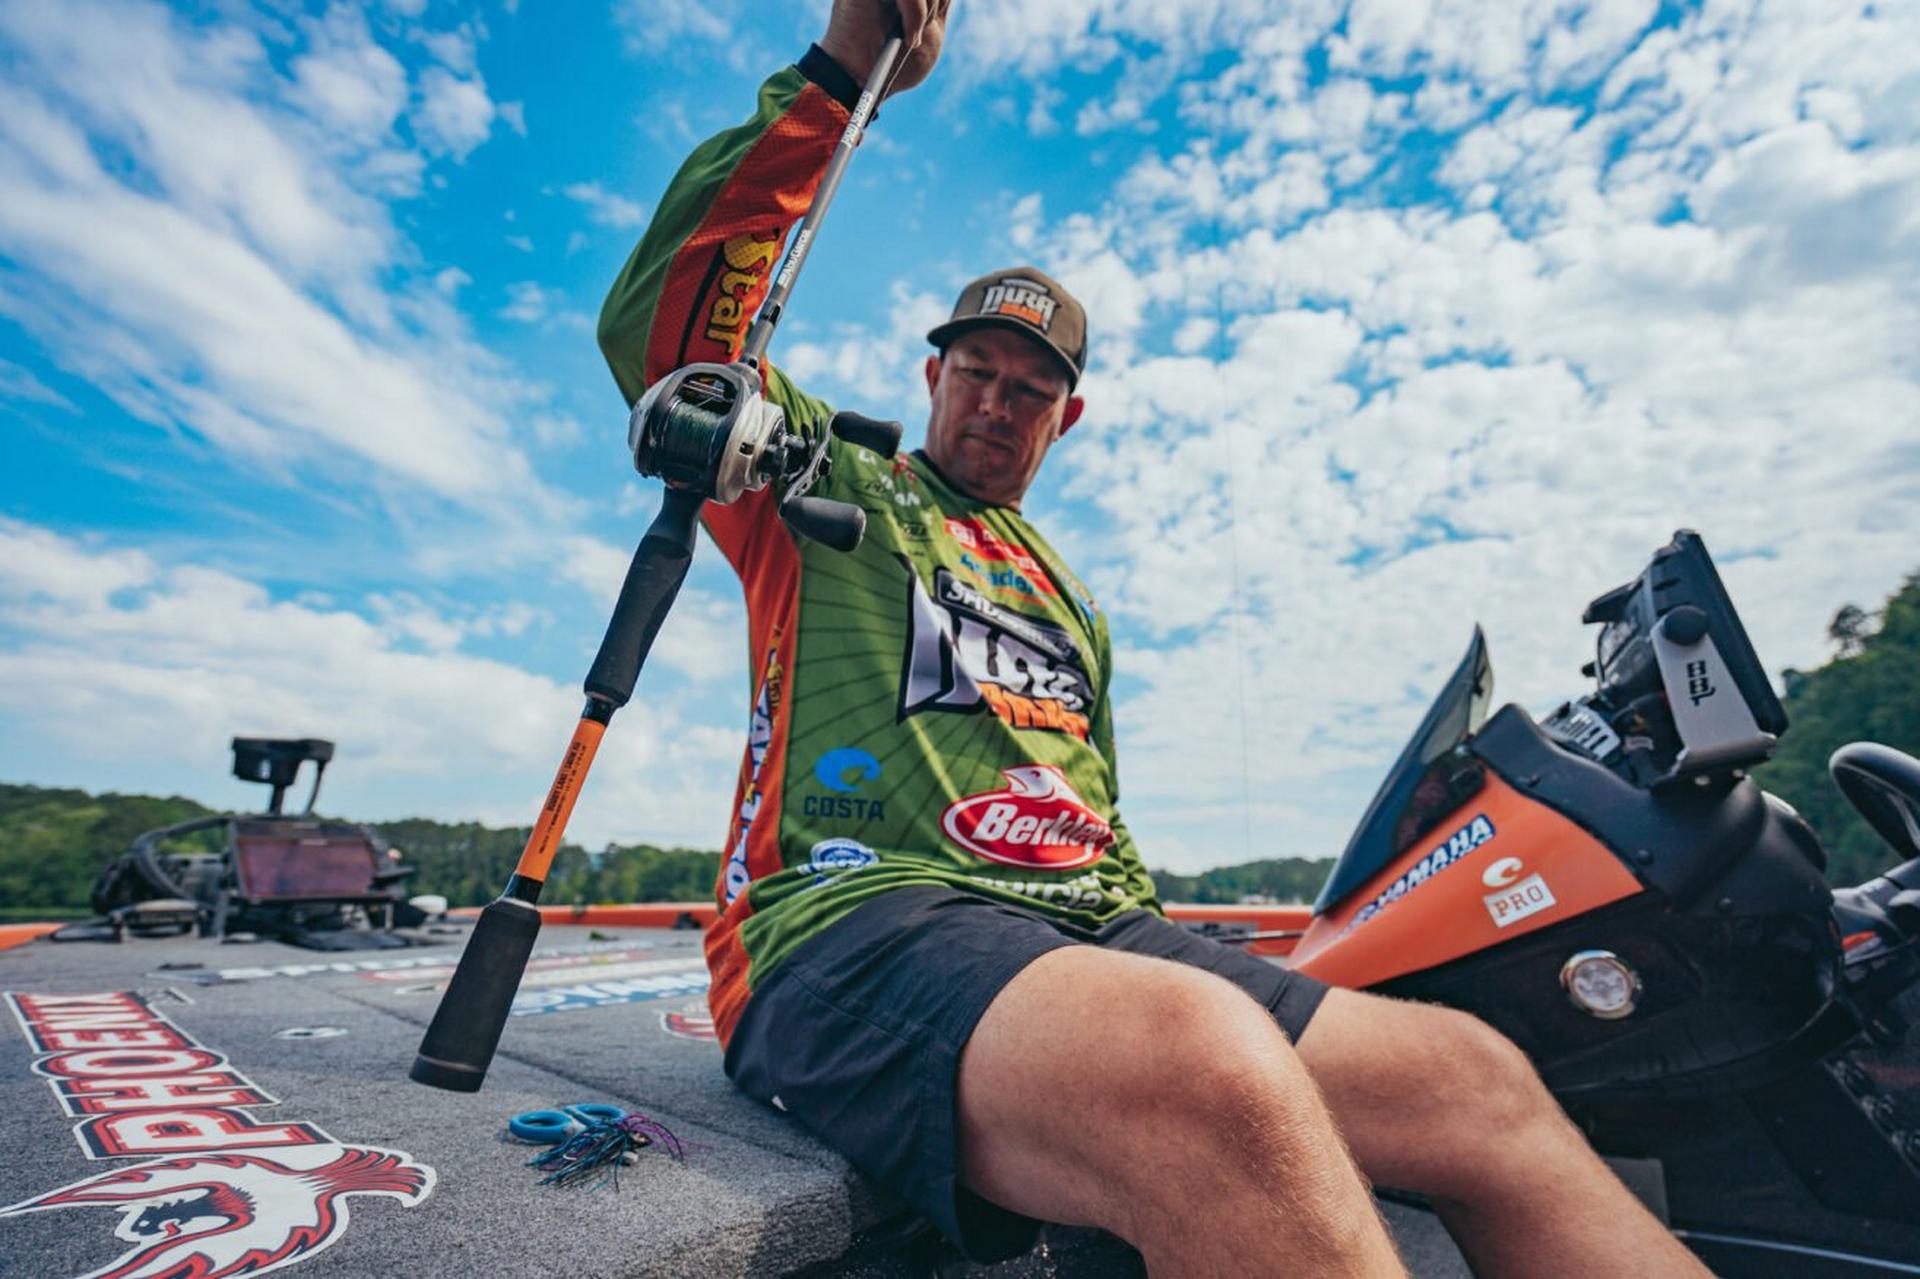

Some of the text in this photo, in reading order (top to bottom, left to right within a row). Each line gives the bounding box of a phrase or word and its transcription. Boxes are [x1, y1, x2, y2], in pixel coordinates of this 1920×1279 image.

[706, 234, 775, 355] Star
[803, 795, 885, 823] COSTA
[970, 802, 1112, 848] Berkley
[1377, 814, 1494, 908] YAMAHA
[1493, 884, 1545, 918] PRO
[4, 991, 324, 1160] PHOENIX
